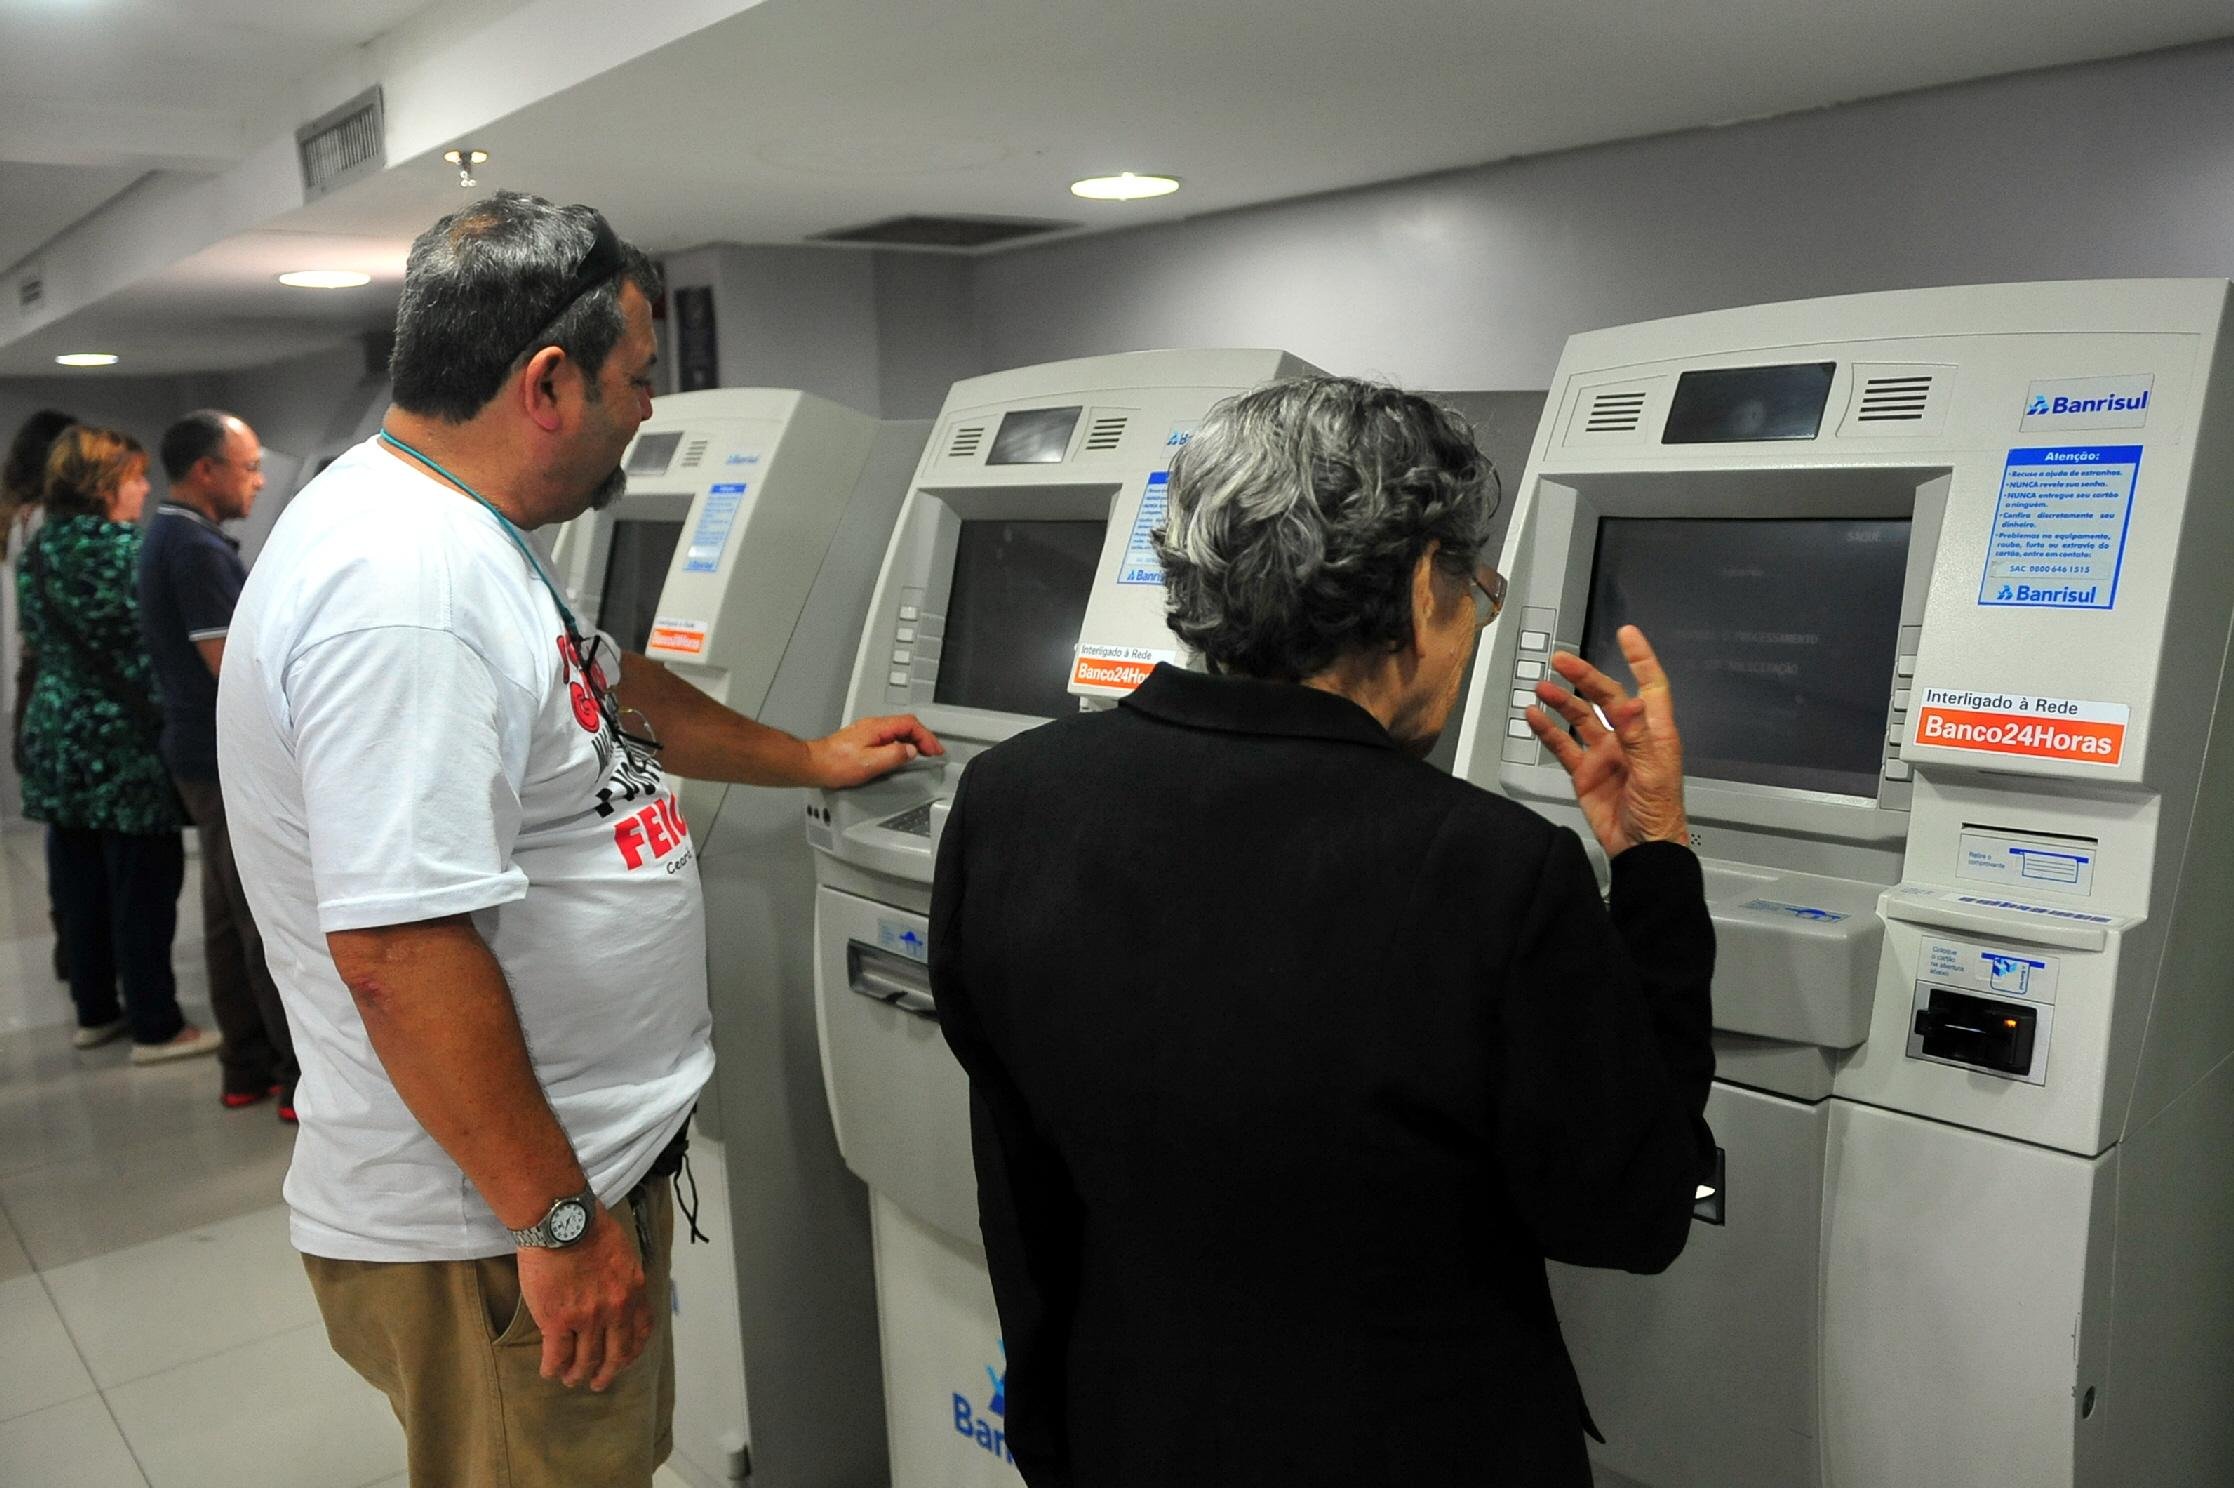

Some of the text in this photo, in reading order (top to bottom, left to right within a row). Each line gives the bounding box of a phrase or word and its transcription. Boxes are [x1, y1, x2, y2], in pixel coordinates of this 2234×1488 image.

[2052, 391, 2149, 414] Banrisul
[2045, 451, 2100, 463] Atenção:
[2069, 469, 2079, 477] de
[2016, 585, 2097, 604] Banrisul
[1081, 644, 1122, 657] Interligado
[1132, 648, 1152, 660] Rede
[1078, 662, 1150, 684] Banco24Ho
[1926, 689, 2078, 715] Interligado à Rede
[1924, 715, 2113, 755] Banco24Horas
